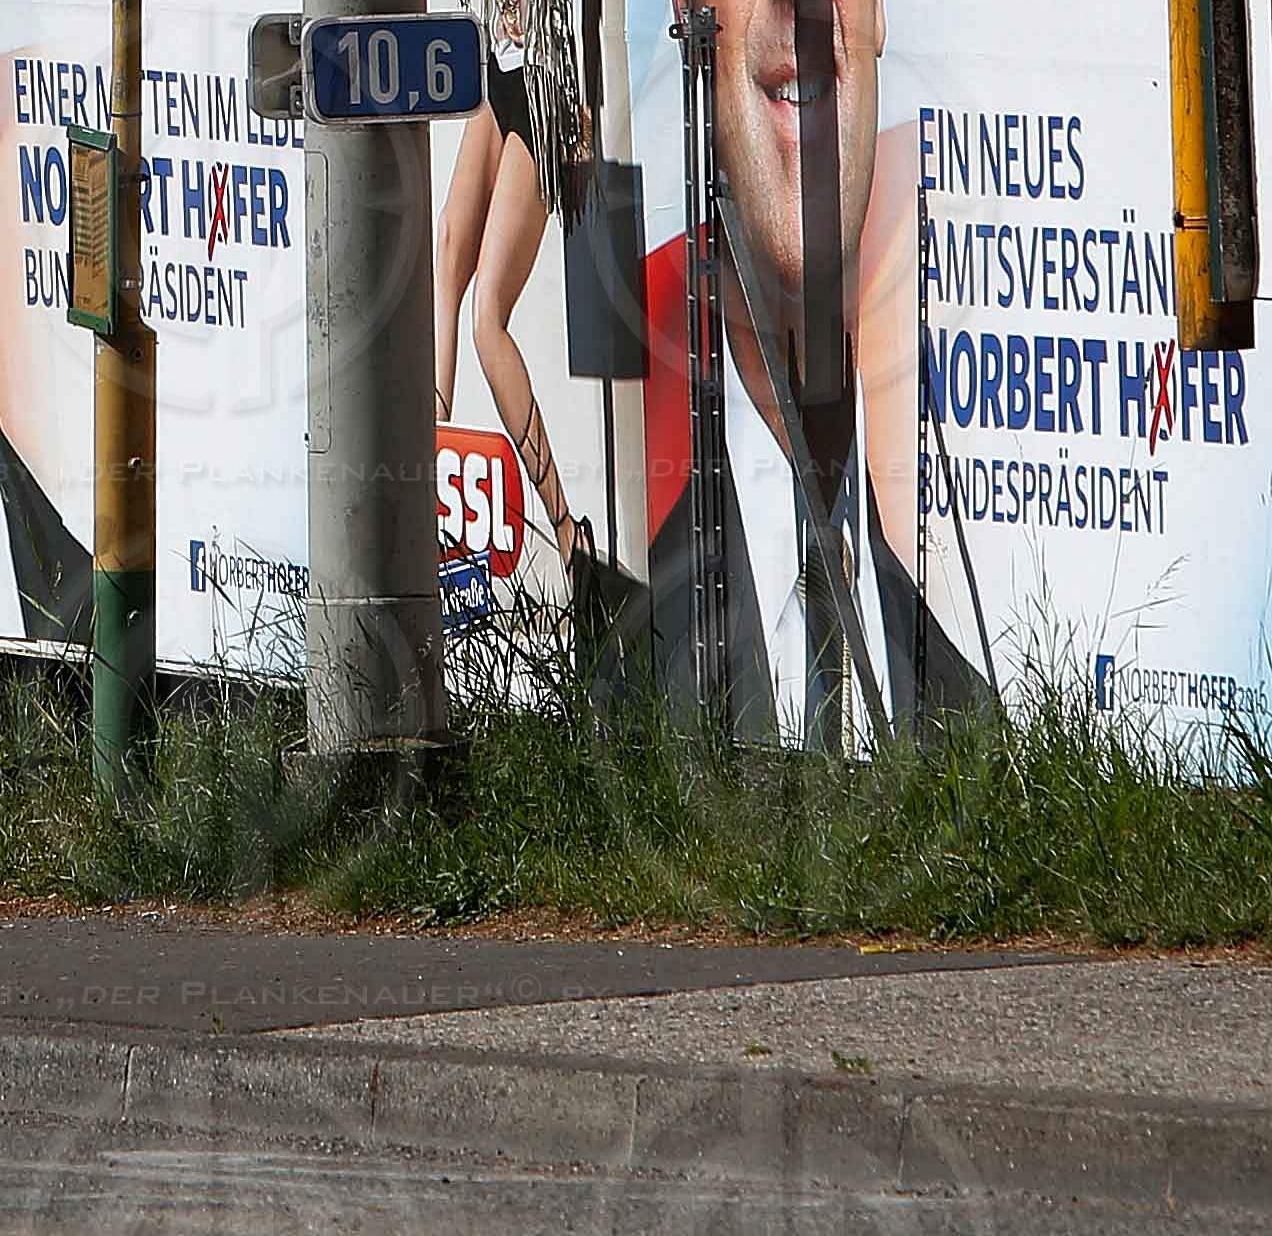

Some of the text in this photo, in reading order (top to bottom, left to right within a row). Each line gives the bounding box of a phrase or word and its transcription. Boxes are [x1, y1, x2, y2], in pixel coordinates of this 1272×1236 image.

[14, 59, 90, 127] EINER
[207, 74, 239, 142] IM
[337, 29, 454, 111] 10,6
[919, 107, 1085, 201] EIN NEUES
[923, 326, 1108, 437] NORBERT
[919, 447, 1169, 535] BUNDESPRÄSIDENT
